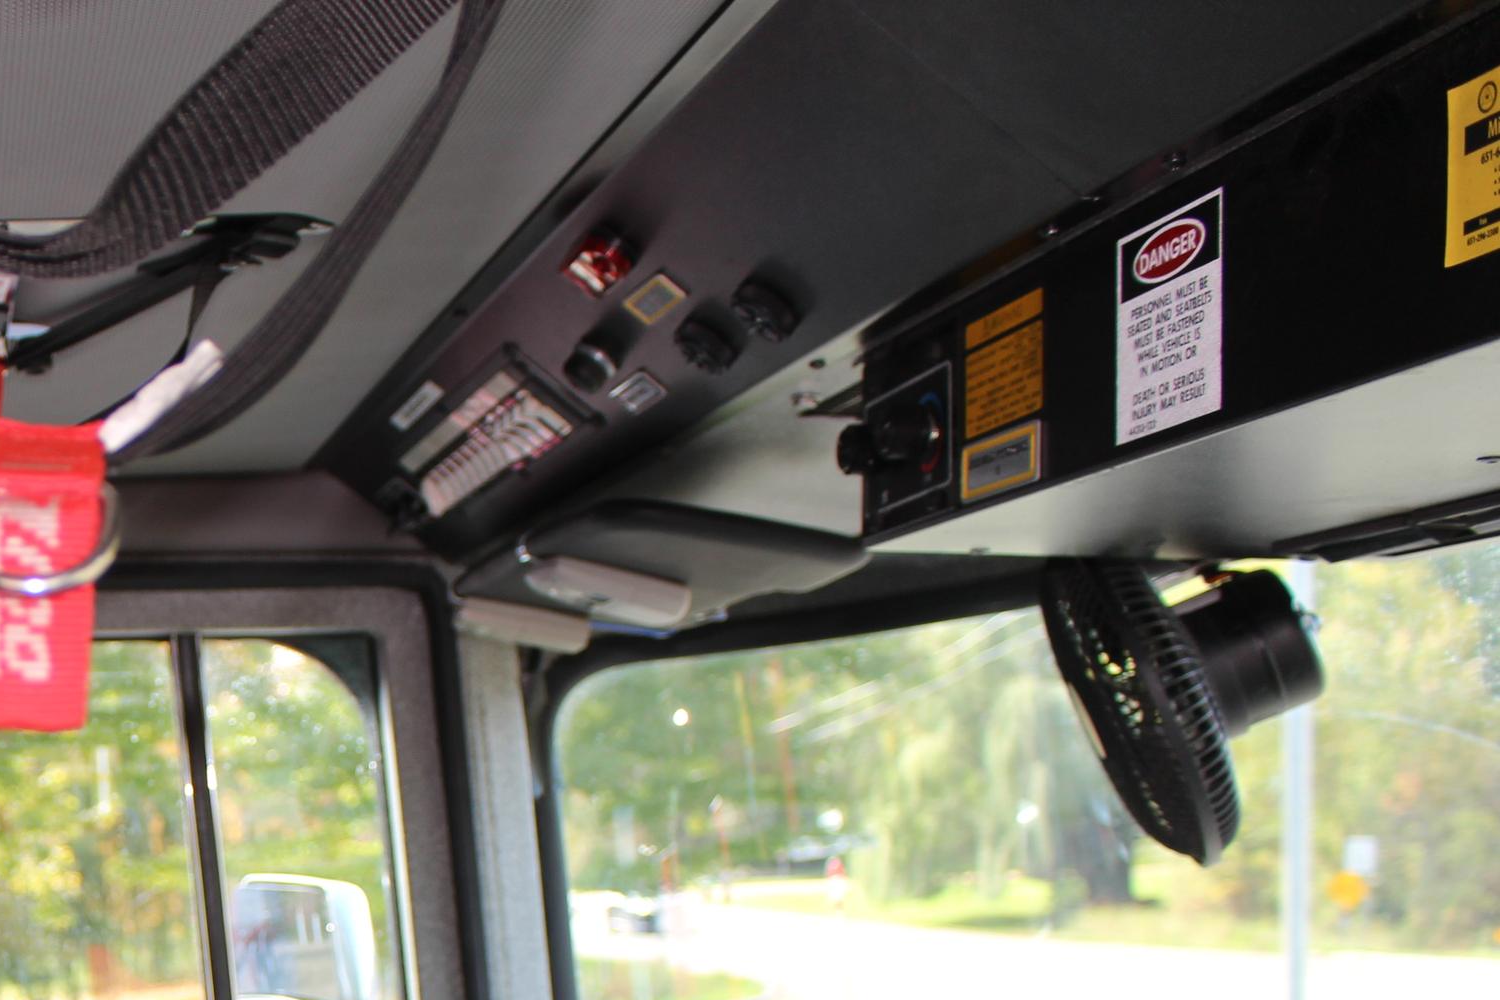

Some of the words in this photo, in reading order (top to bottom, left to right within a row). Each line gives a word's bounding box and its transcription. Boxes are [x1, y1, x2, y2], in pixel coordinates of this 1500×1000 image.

[1140, 228, 1197, 275] DANGER
[1127, 317, 1152, 338] SEATED
[1155, 308, 1172, 325] AND
[1175, 290, 1212, 317] SEATBELTS
[1131, 292, 1172, 320] PERSONNEL
[1176, 281, 1196, 300] MUST
[1199, 275, 1208, 290] BE
[1134, 332, 1153, 349] MUST
[1156, 326, 1165, 341] BE
[1167, 310, 1205, 335] FASTENED
[1137, 344, 1159, 363] WHILE
[1162, 331, 1191, 353] VEHICLE
[1194, 326, 1202, 341] IS
[1140, 365, 1148, 377] IN
[1151, 352, 1182, 373] MOTION
[1185, 345, 1197, 360] OR
[1132, 388, 1156, 406] DEATH
[1158, 382, 1170, 396] OR
[1172, 368, 1205, 391] SERIOUS
[1132, 403, 1157, 420] INJURY
[1160, 395, 1177, 411] MAY
[1180, 383, 1206, 402] RESULT
